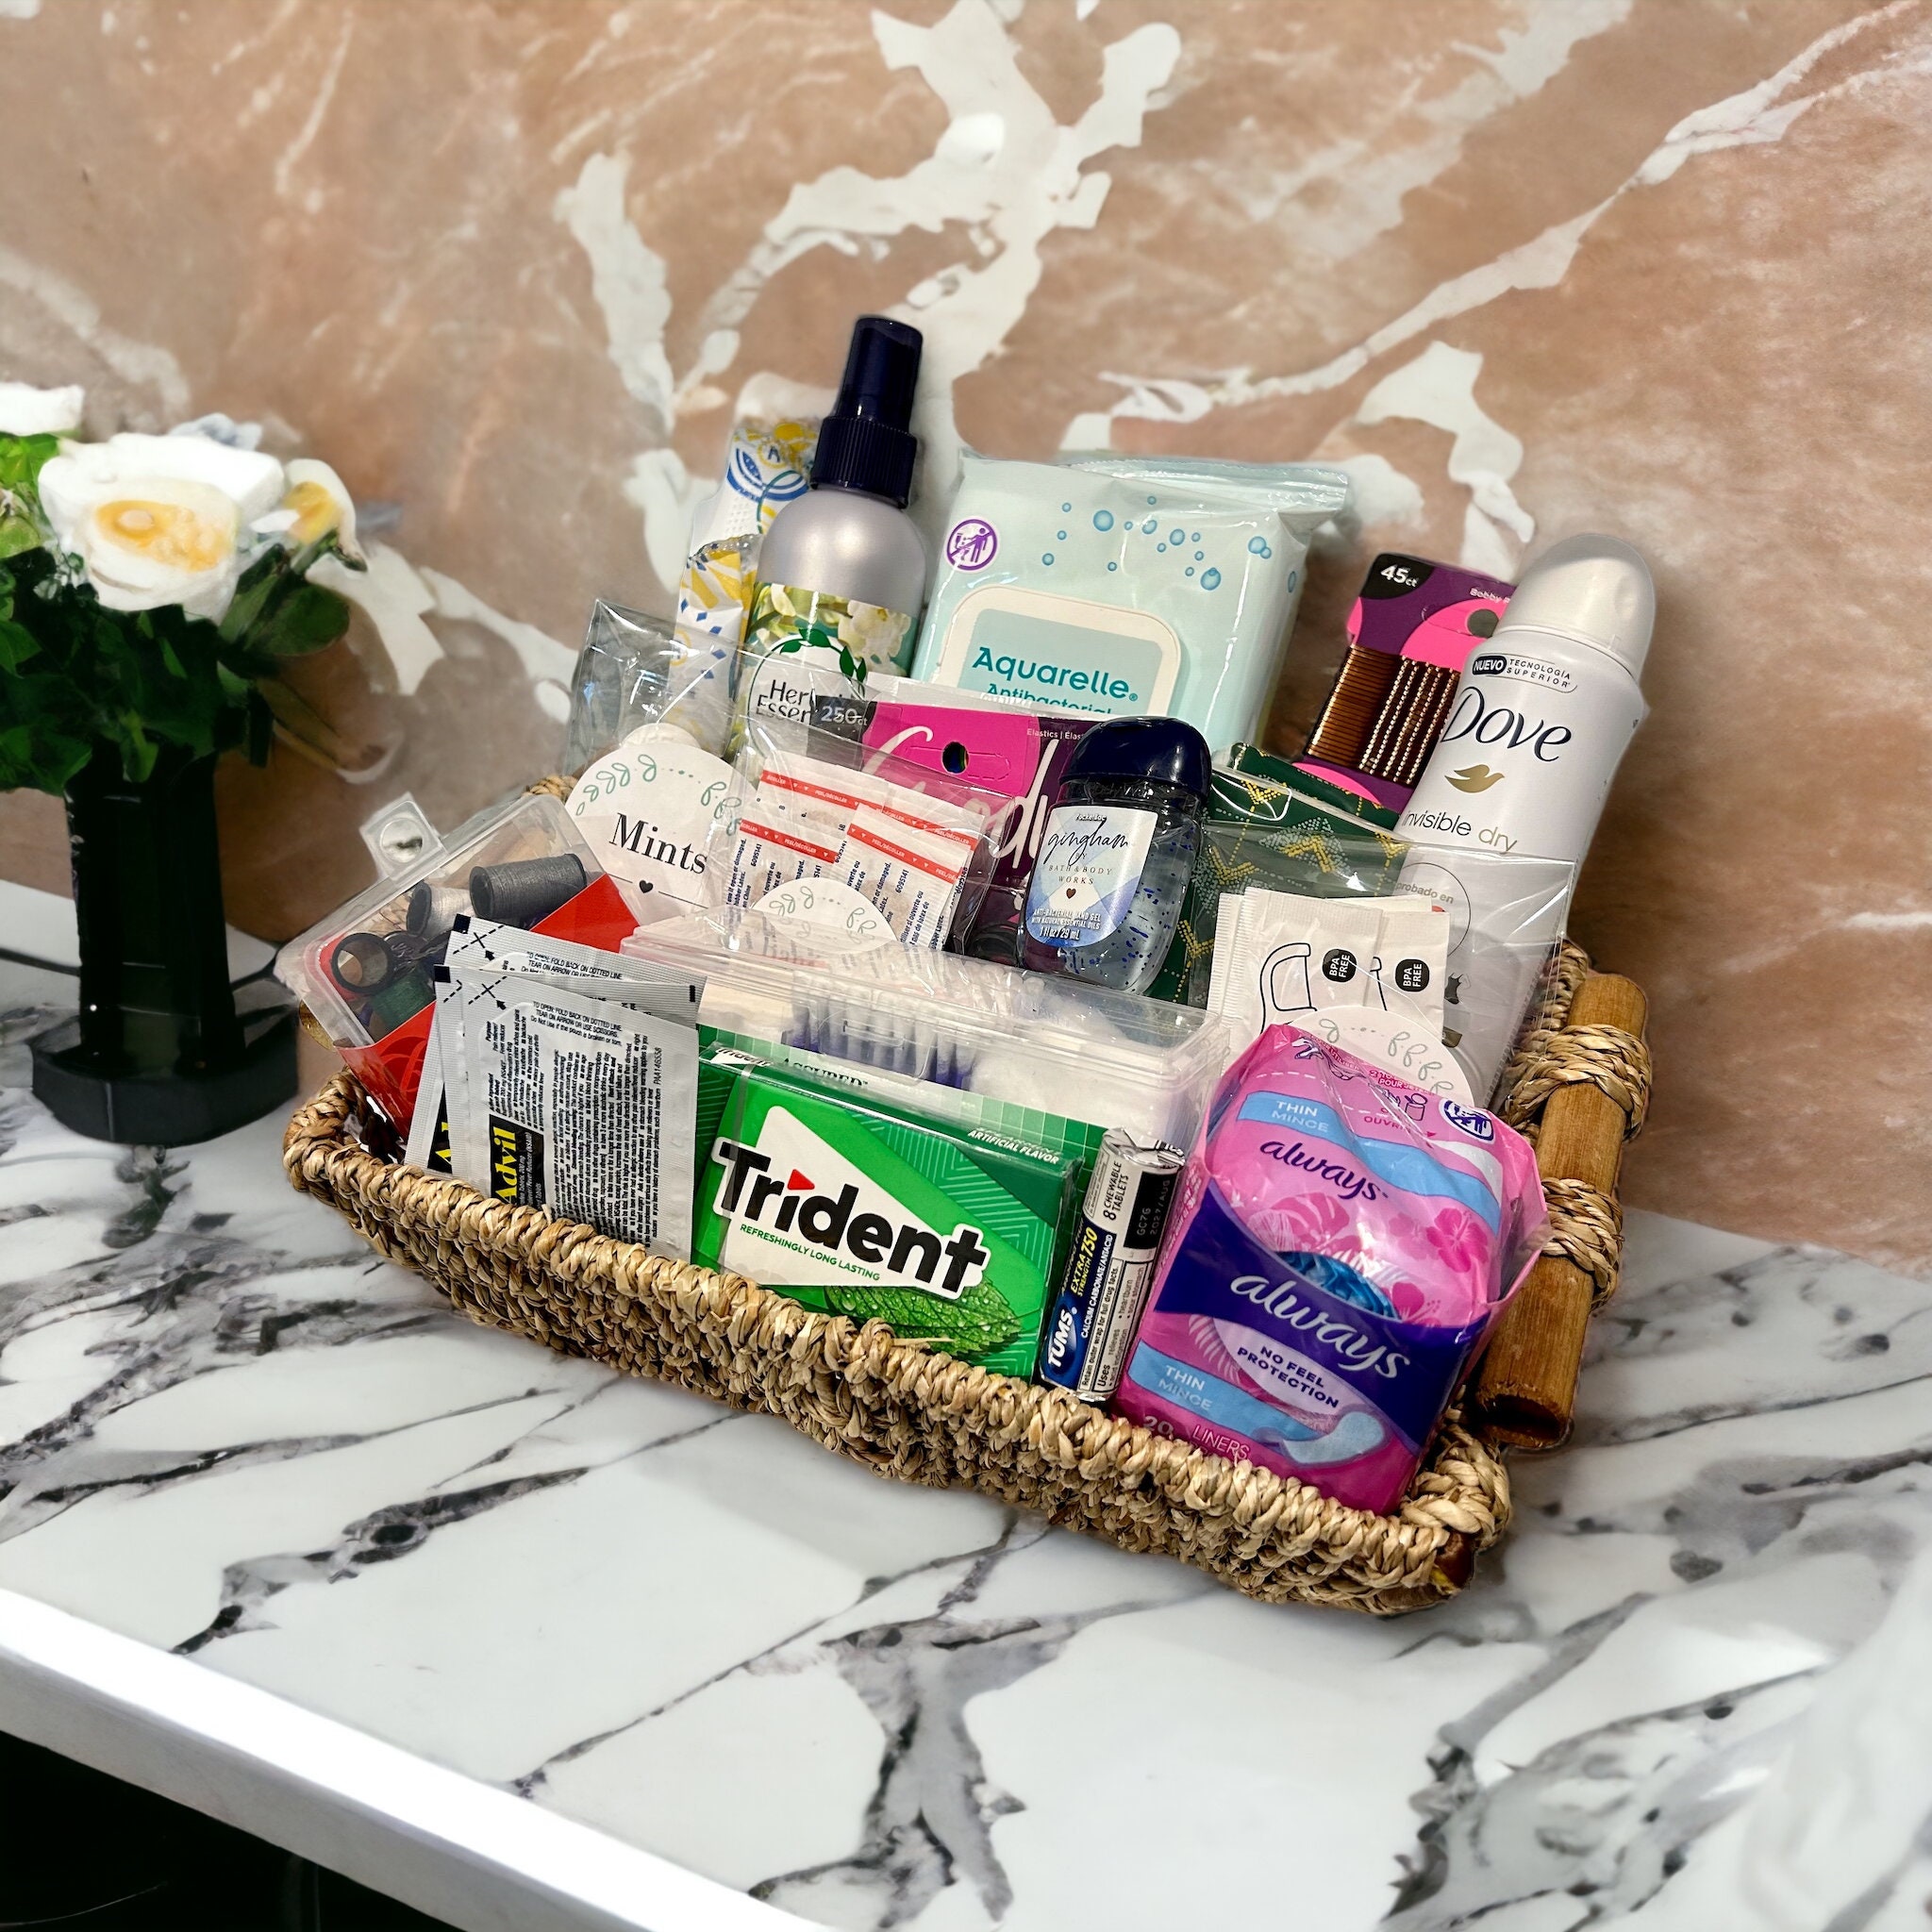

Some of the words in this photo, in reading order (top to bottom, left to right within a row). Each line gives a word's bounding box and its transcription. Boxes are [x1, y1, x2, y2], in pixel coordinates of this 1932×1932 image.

[1380, 565, 1417, 588] 45ct
[1470, 588, 1503, 604] Bobby
[1474, 659, 1505, 673] NUEVO
[1506, 666, 1568, 687] SUPERIOR
[1026, 727, 1058, 740] Elastics
[1440, 686, 1573, 762] Dove
[1043, 817, 1128, 866] gingham
[1401, 810, 1472, 837] invisible
[1477, 826, 1518, 852] dry
[608, 812, 708, 874] Mints
[733, 837, 746, 865] damaged.
[729, 873, 738, 887] open
[737, 870, 746, 888] Latex.
[742, 885, 751, 900] Chine
[750, 842, 761, 866] 6095141
[762, 870, 774, 891] ouverte
[846, 868, 858, 887] uverte
[875, 860, 891, 890] damaged.
[894, 868, 908, 893] 6095141
[1058, 875, 1094, 885] WORKS
[853, 878, 862, 891] atex
[908, 897, 920, 920] ouverte
[1440, 893, 1454, 905] en
[917, 909, 926, 924] latex
[527, 959, 541, 968] TEAR
[550, 965, 570, 974] ARROW
[550, 957, 564, 966] FOLD
[589, 966, 609, 977] DOTTED
[1328, 957, 1340, 977] BPA
[1340, 954, 1350, 978] FREE
[1403, 967, 1412, 988] BPA
[1412, 963, 1423, 988] FREE
[535, 1008, 548, 1017] TEAR
[556, 1015, 575, 1024] ARROW
[568, 1011, 581, 1020] BACK
[590, 1018, 610, 1027] DOTTED
[568, 1027, 582, 1036] pouch
[587, 1033, 605, 1041] broken
[1379, 1078, 1403, 1089] POUR
[1276, 1100, 1317, 1117] THIN
[1272, 1110, 1328, 1133] MINCE
[968, 1130, 1020, 1152] ARTIFICIAL
[1020, 1145, 1059, 1164] FLAVOR
[493, 1127, 518, 1206] Advil
[1259, 1141, 1381, 1201] always
[1103, 1161, 1122, 1208] CHEWABLE
[1111, 1174, 1129, 1212] TABLETS
[719, 1141, 988, 1292] Trident
[1103, 1208, 1117, 1221] 8
[740, 1224, 808, 1255] REFRESHINGLY
[809, 1250, 839, 1266] LONG
[838, 1259, 880, 1281] LASTING
[1081, 1226, 1098, 1257] 750
[1071, 1255, 1086, 1292] EXTRA
[1077, 1257, 1091, 1296] STRENGTH
[1108, 1265, 1119, 1285] facts.
[1104, 1286, 1114, 1302] drug
[1100, 1303, 1108, 1314] full
[1080, 1306, 1095, 1339] CALCIUM
[1097, 1363, 1110, 1387] Uses
[1107, 1327, 1120, 1356] relieves
[1118, 1278, 1133, 1313] heartburn
[1230, 1274, 1411, 1378] always
[1092, 1327, 1103, 1344] wrap
[1088, 1346, 1097, 1363] outer
[1081, 1364, 1093, 1386] Retain
[1164, 1365, 1205, 1391] THIN
[1237, 1347, 1340, 1408] PROTECTION
[1259, 1346, 1284, 1364] NO
[1287, 1360, 1325, 1388] FEEL
[1158, 1379, 1212, 1409] MINCE
[1142, 1415, 1174, 1436] 20
[1192, 1424, 1251, 1460] LINERS
